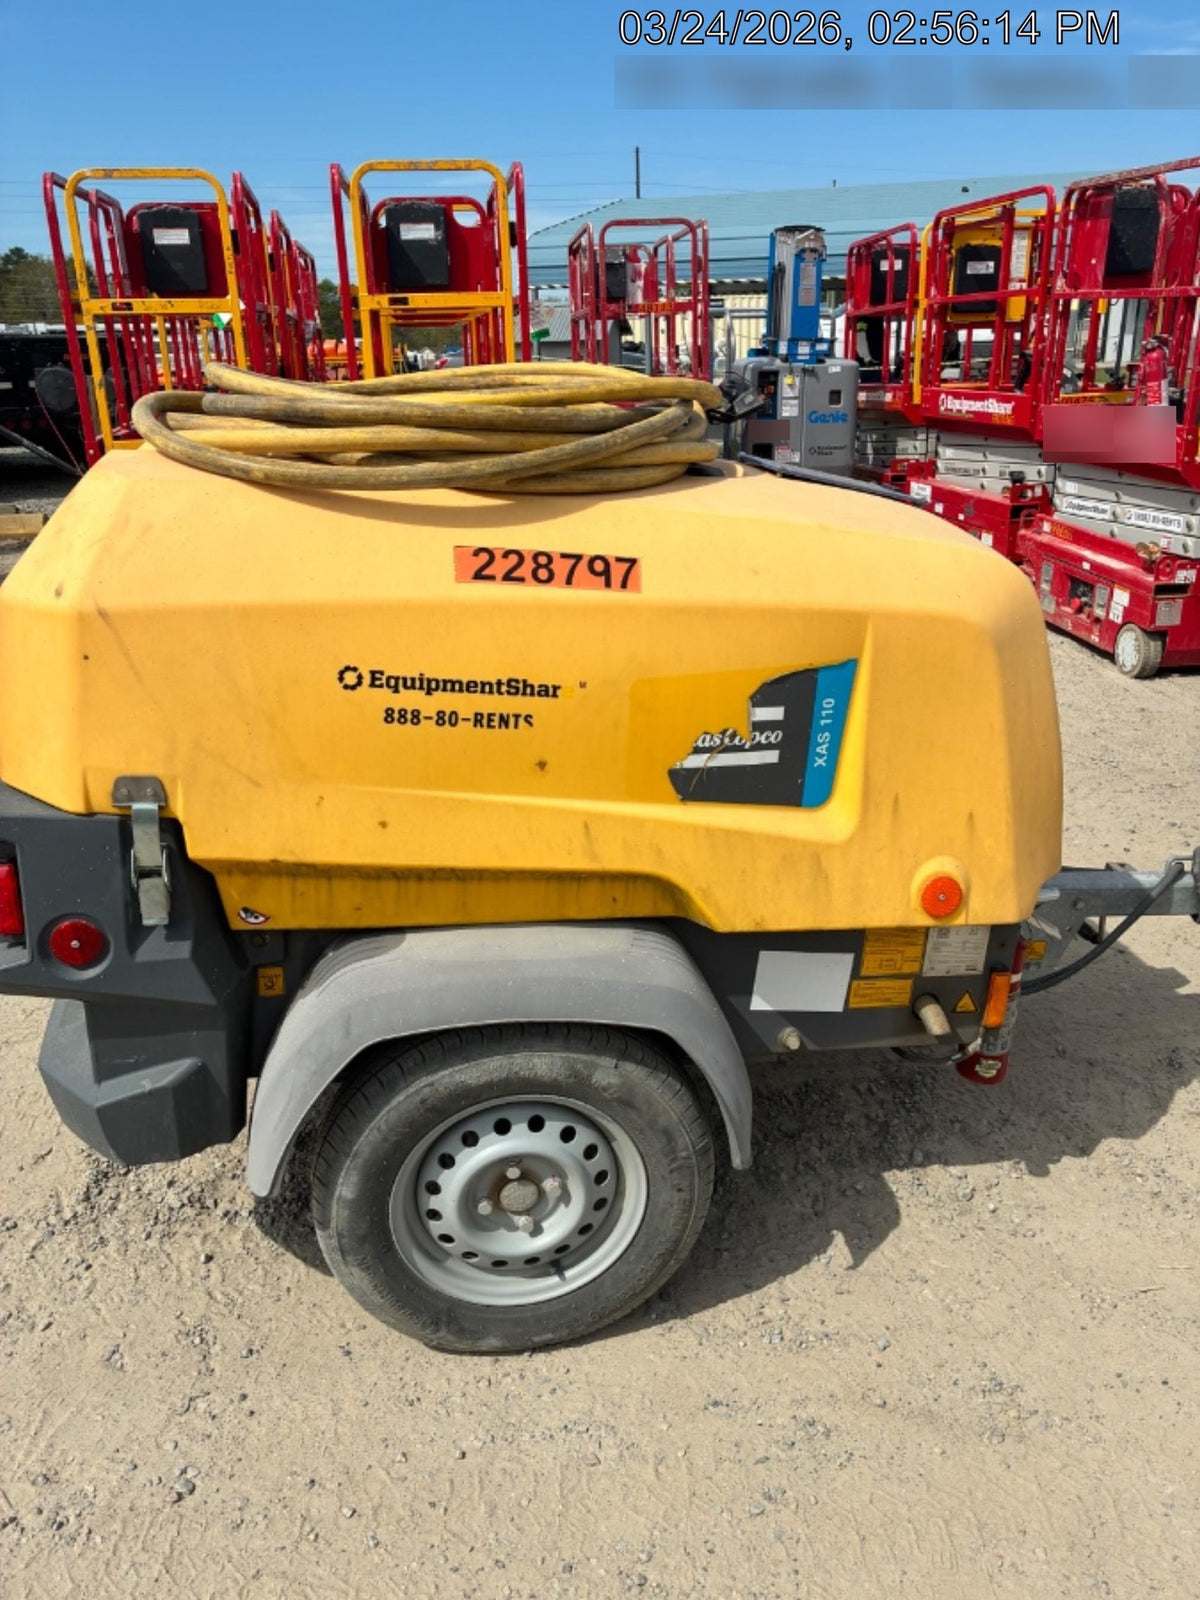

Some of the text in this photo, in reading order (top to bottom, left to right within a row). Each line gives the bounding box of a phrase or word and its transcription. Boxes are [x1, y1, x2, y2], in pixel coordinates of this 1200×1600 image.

[808, 409, 848, 424] Genie
[472, 546, 639, 591] 228797
[368, 669, 567, 699] EquipmentShar
[383, 707, 534, 730] 888-80-RENTS
[814, 697, 836, 767] XAS 110
